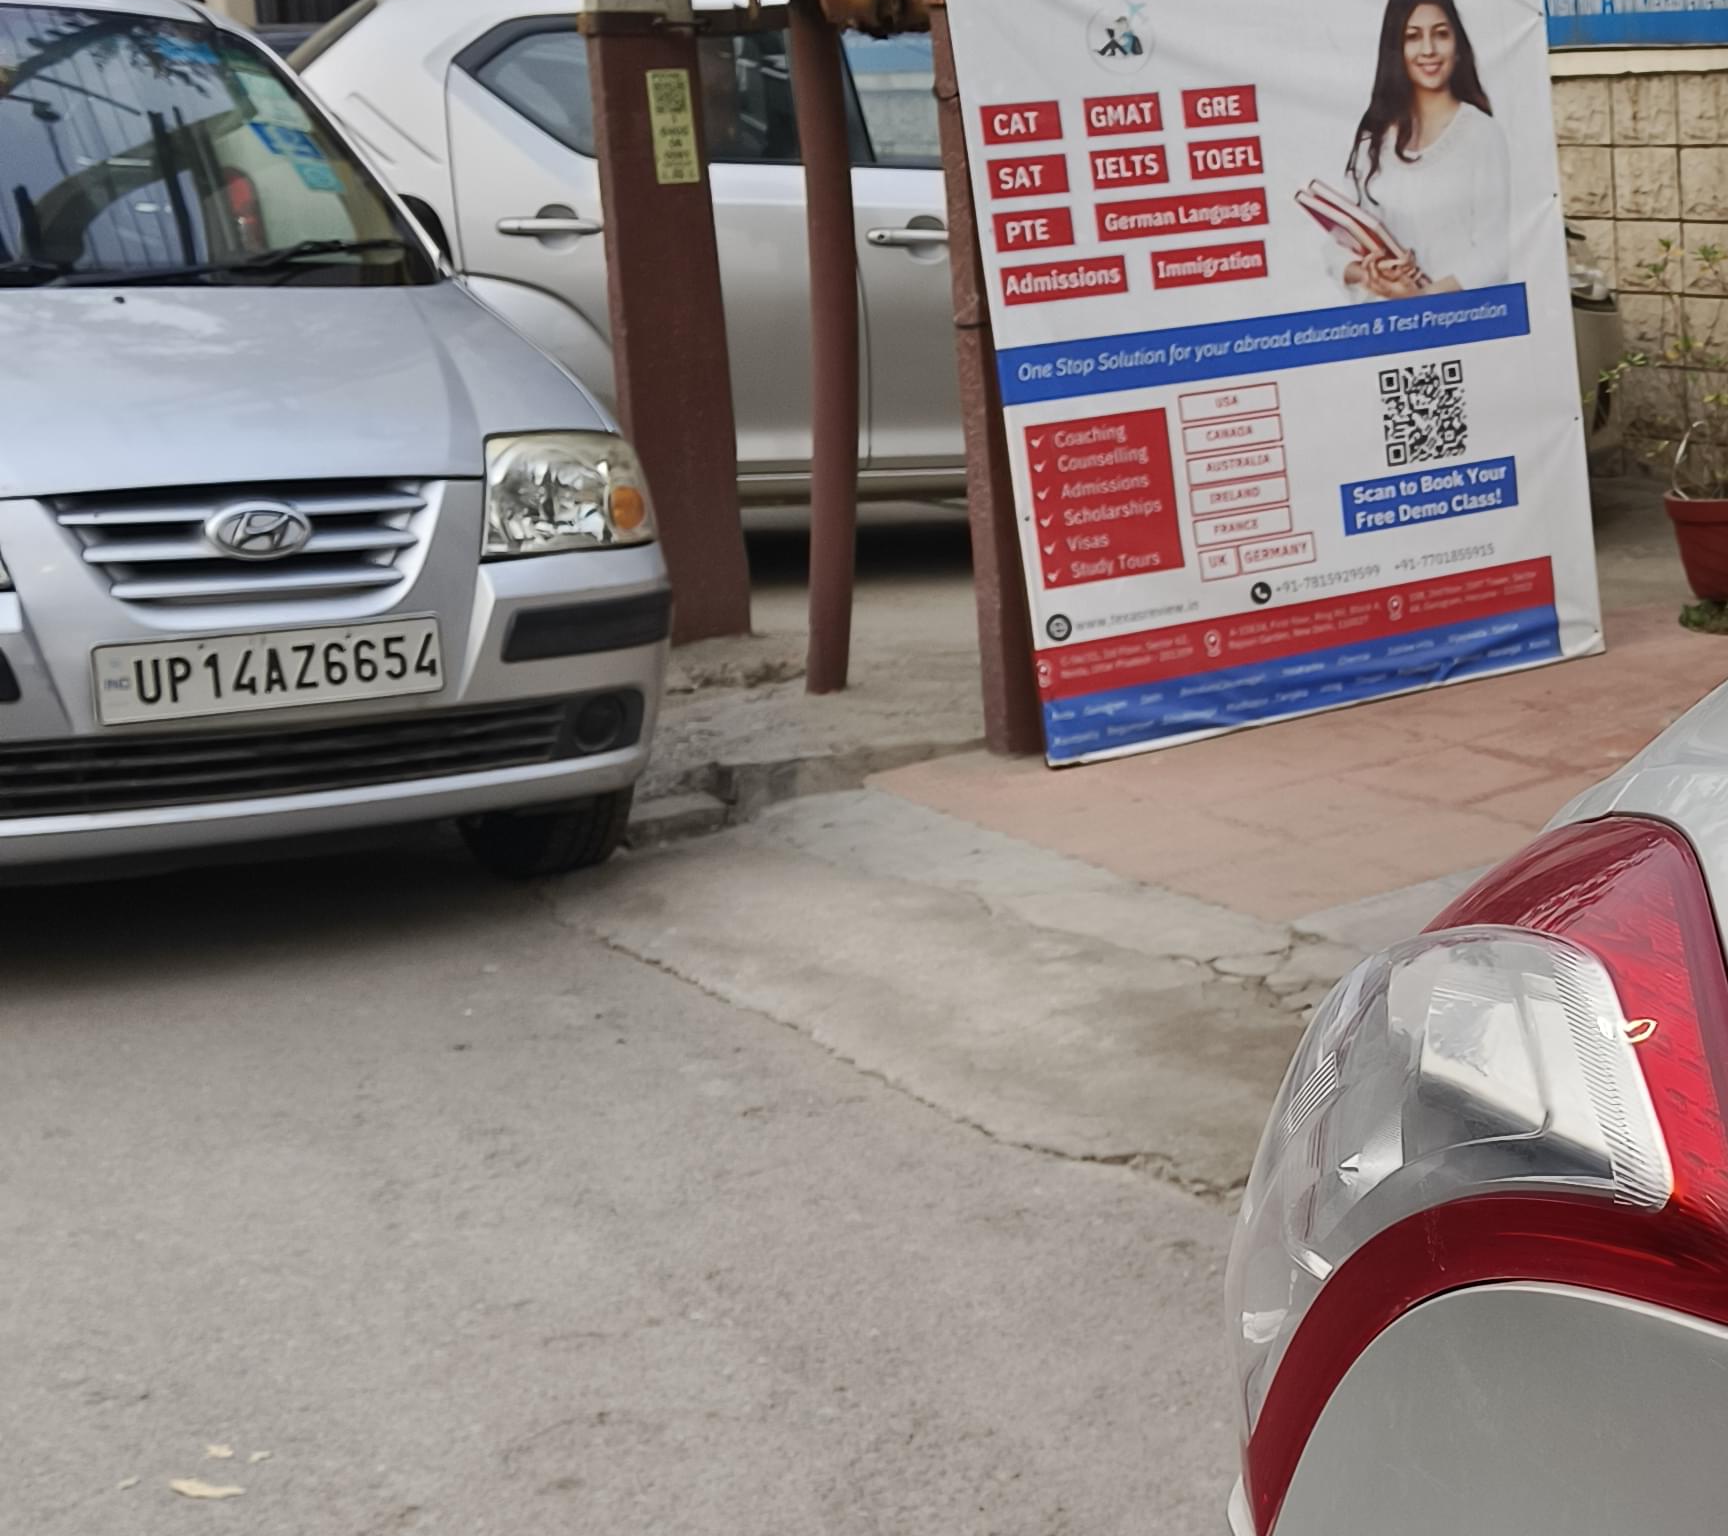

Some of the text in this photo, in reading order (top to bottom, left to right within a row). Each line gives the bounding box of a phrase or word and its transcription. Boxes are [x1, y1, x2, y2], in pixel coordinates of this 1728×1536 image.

[993, 94, 1242, 137] CAT GMAT GRE
[998, 145, 1261, 191] SAT IELTS TOEFL
[1005, 200, 1262, 244] PTE German Language
[1005, 250, 1264, 296] Admissions Immigration
[1017, 300, 1509, 382] One Stop Solution for your abroad education & Test Preparation
[1214, 396, 1240, 410] USA
[1053, 424, 1128, 449] Coaching
[1205, 424, 1254, 442] CANADA
[1056, 445, 1150, 474] Counselling
[1205, 453, 1271, 474] AUSTRALIA
[1060, 473, 1151, 500] Admissions
[1209, 486, 1261, 505] IRELAND
[1352, 465, 1508, 505] Scan to Book Your
[1063, 498, 1163, 527] Scholarships
[1355, 487, 1503, 531] Free Demo Class!
[1213, 518, 1260, 536] FRANCE
[1065, 533, 1110, 552] Visas
[1243, 540, 1309, 564] GERMANY
[1070, 551, 1162, 580] Study Tours
[1207, 555, 1228, 570] UK
[133, 631, 439, 705] UP14AZ6654
